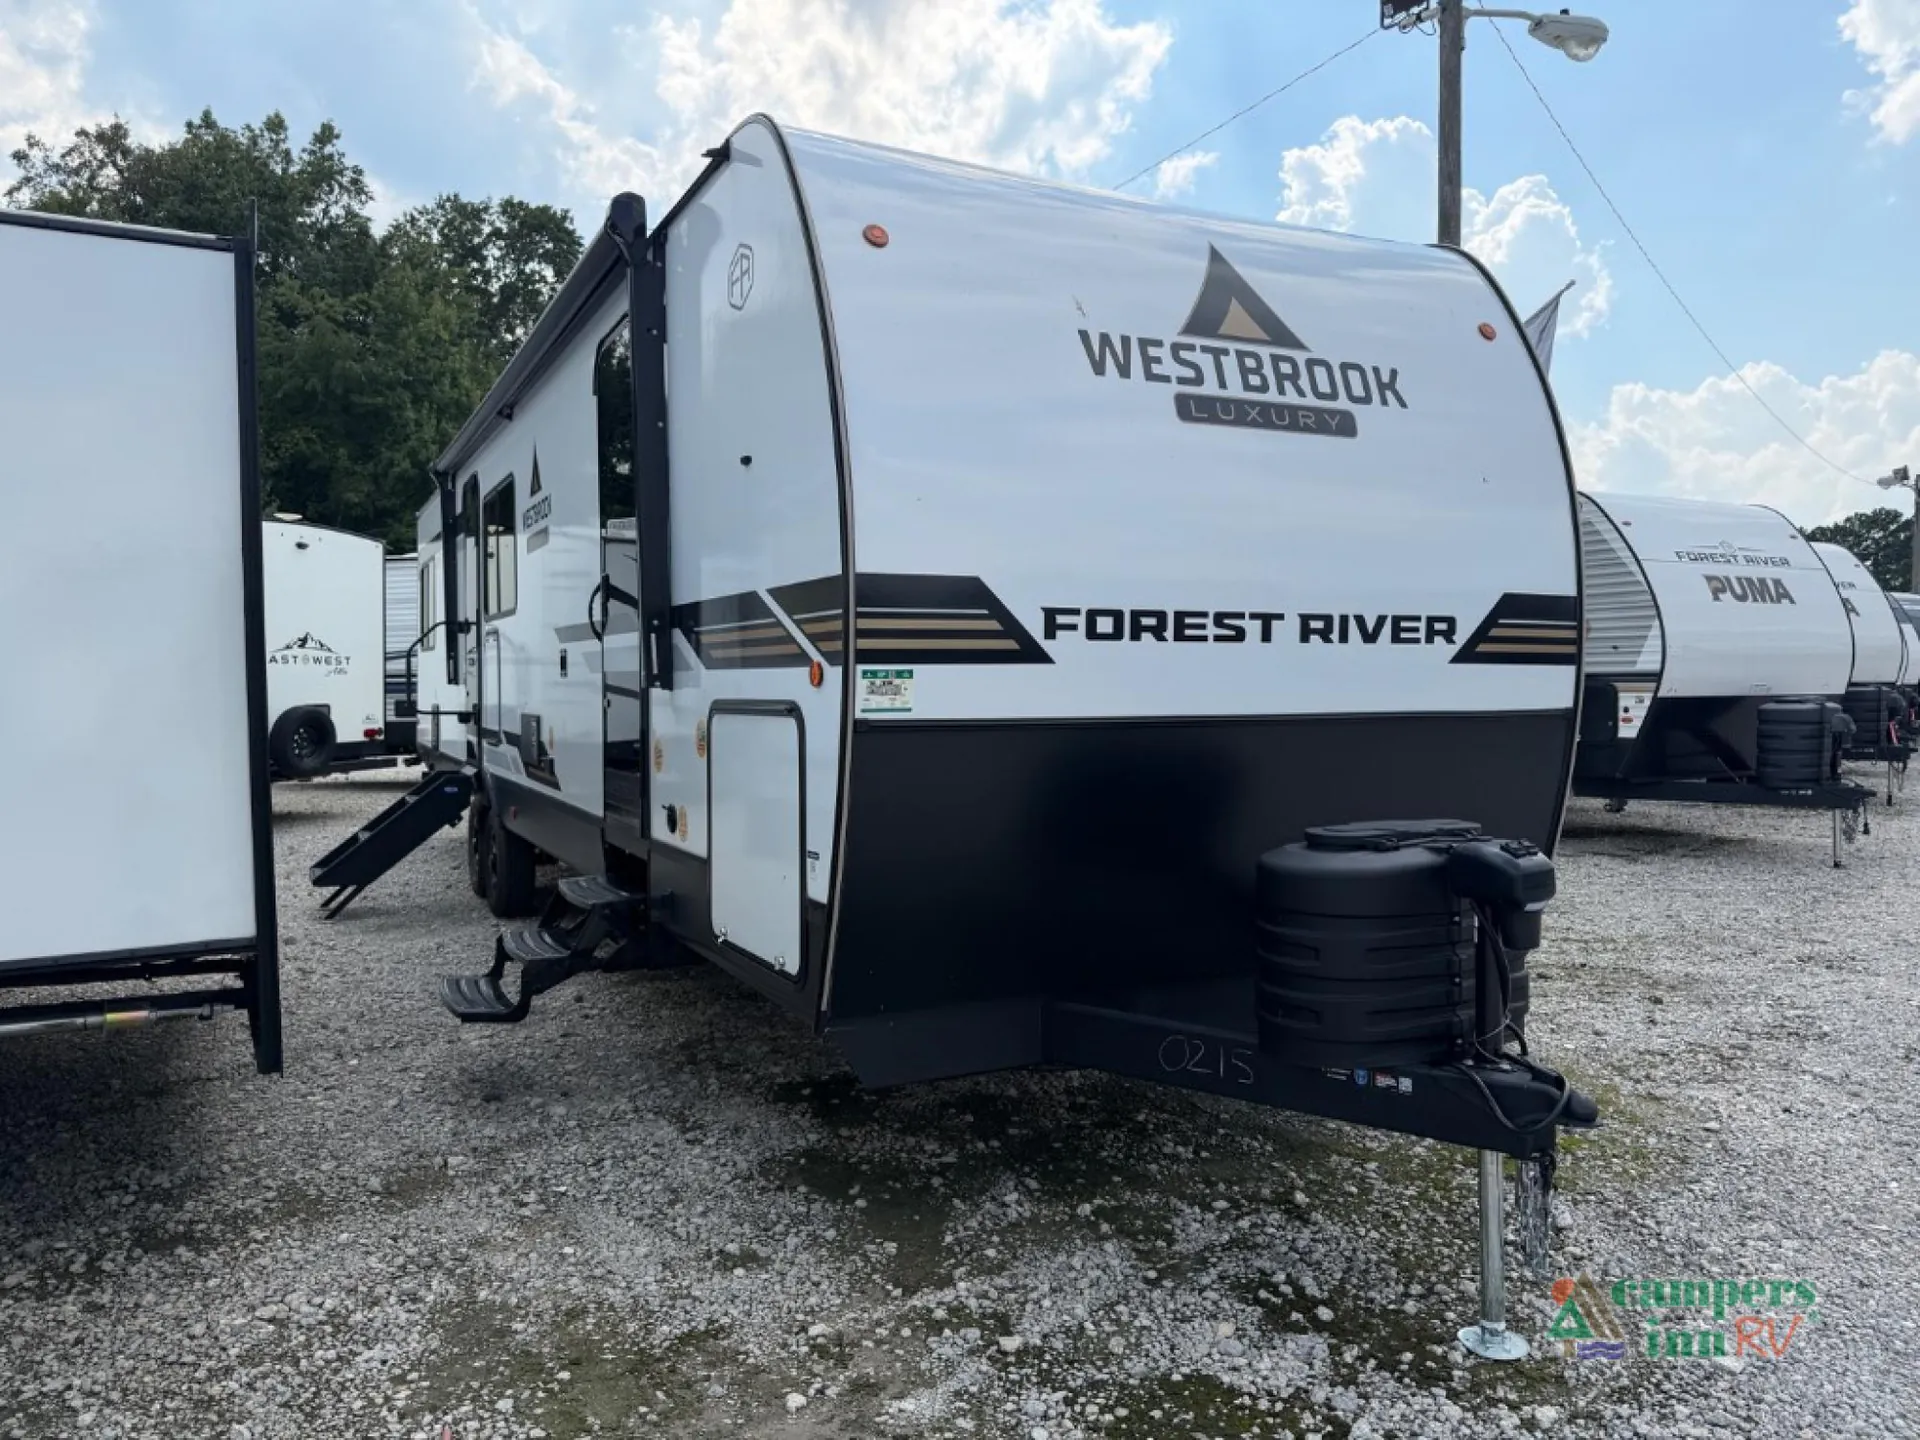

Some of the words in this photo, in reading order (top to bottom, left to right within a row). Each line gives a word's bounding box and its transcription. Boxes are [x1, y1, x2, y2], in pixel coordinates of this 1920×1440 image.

[1077, 328, 1409, 409] WESTBROOK
[1190, 399, 1341, 430] LUXURY
[1675, 550, 1740, 564] FOREST
[1743, 555, 1792, 567] RIVER
[1702, 574, 1797, 605] PUMA
[1040, 606, 1285, 643] FOREST
[1297, 612, 1458, 645] RIVER
[268, 654, 299, 665] AST
[312, 655, 351, 666] WEST
